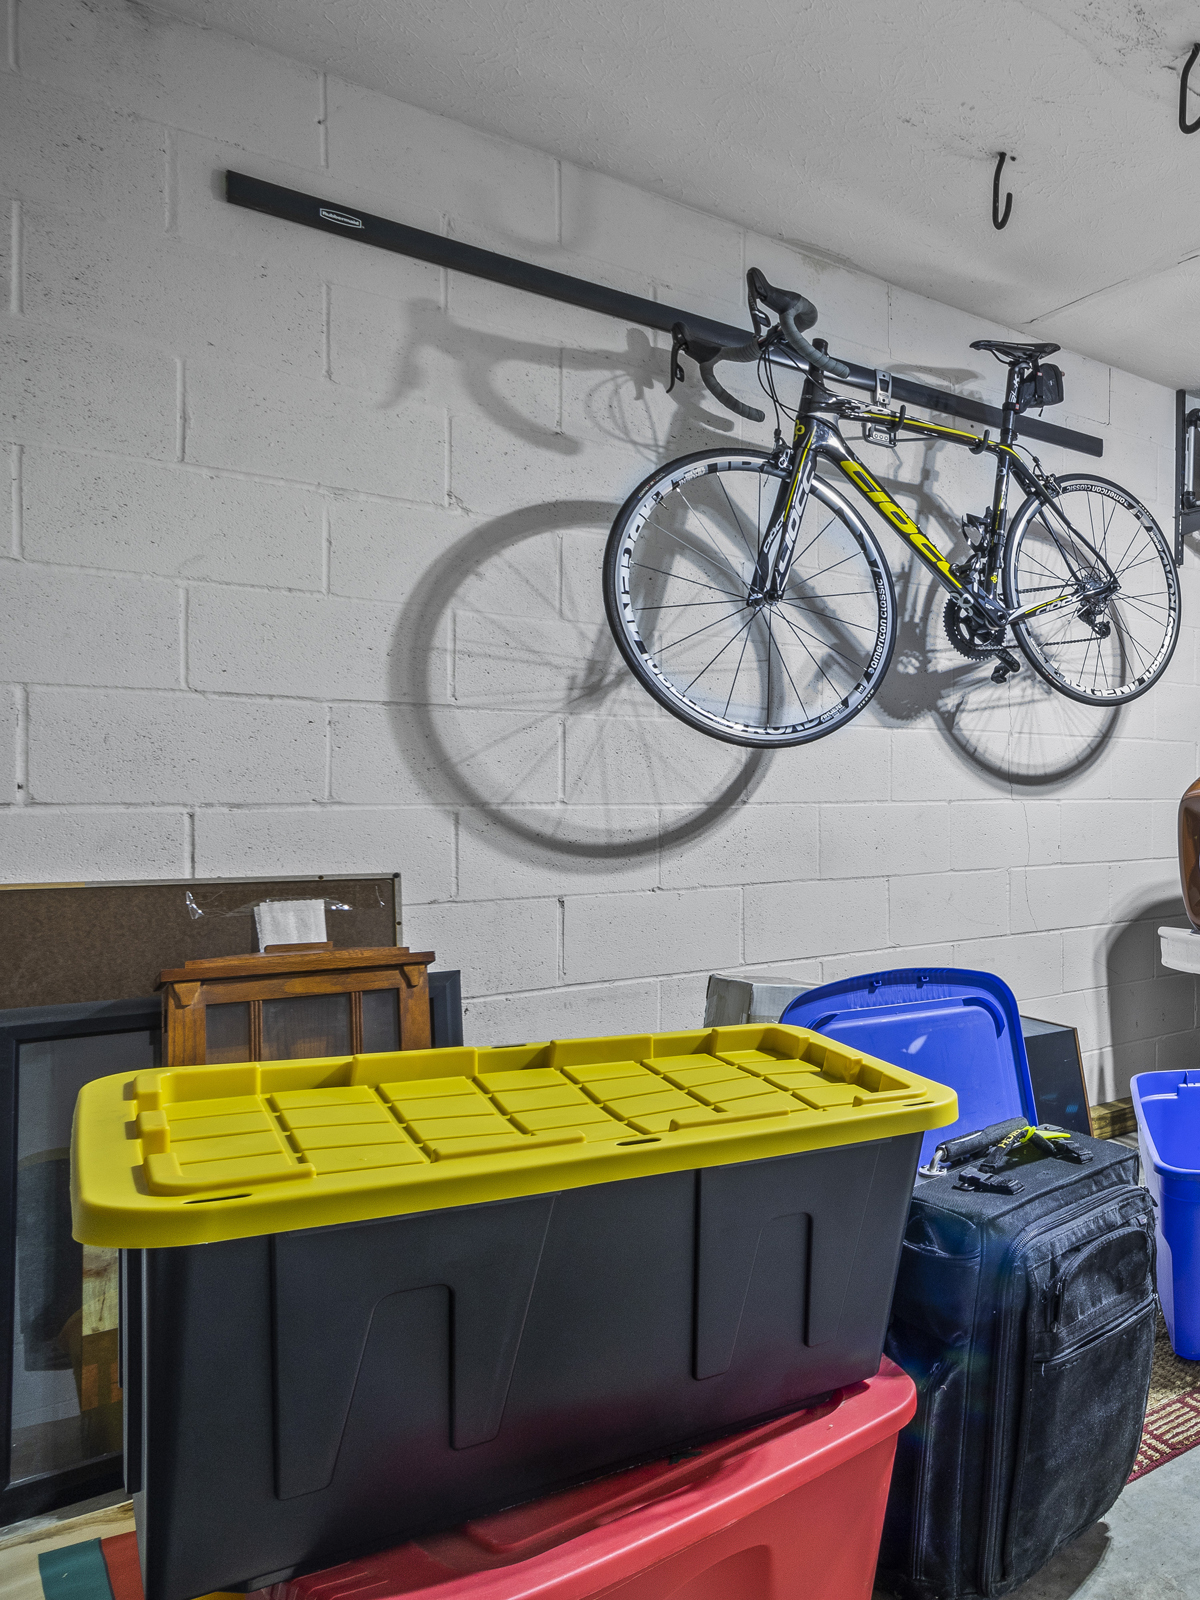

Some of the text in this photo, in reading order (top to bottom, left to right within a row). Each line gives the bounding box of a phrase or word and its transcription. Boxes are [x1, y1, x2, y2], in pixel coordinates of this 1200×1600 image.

[322, 211, 360, 226] Rubbermaid
[870, 577, 888, 669] american classic
